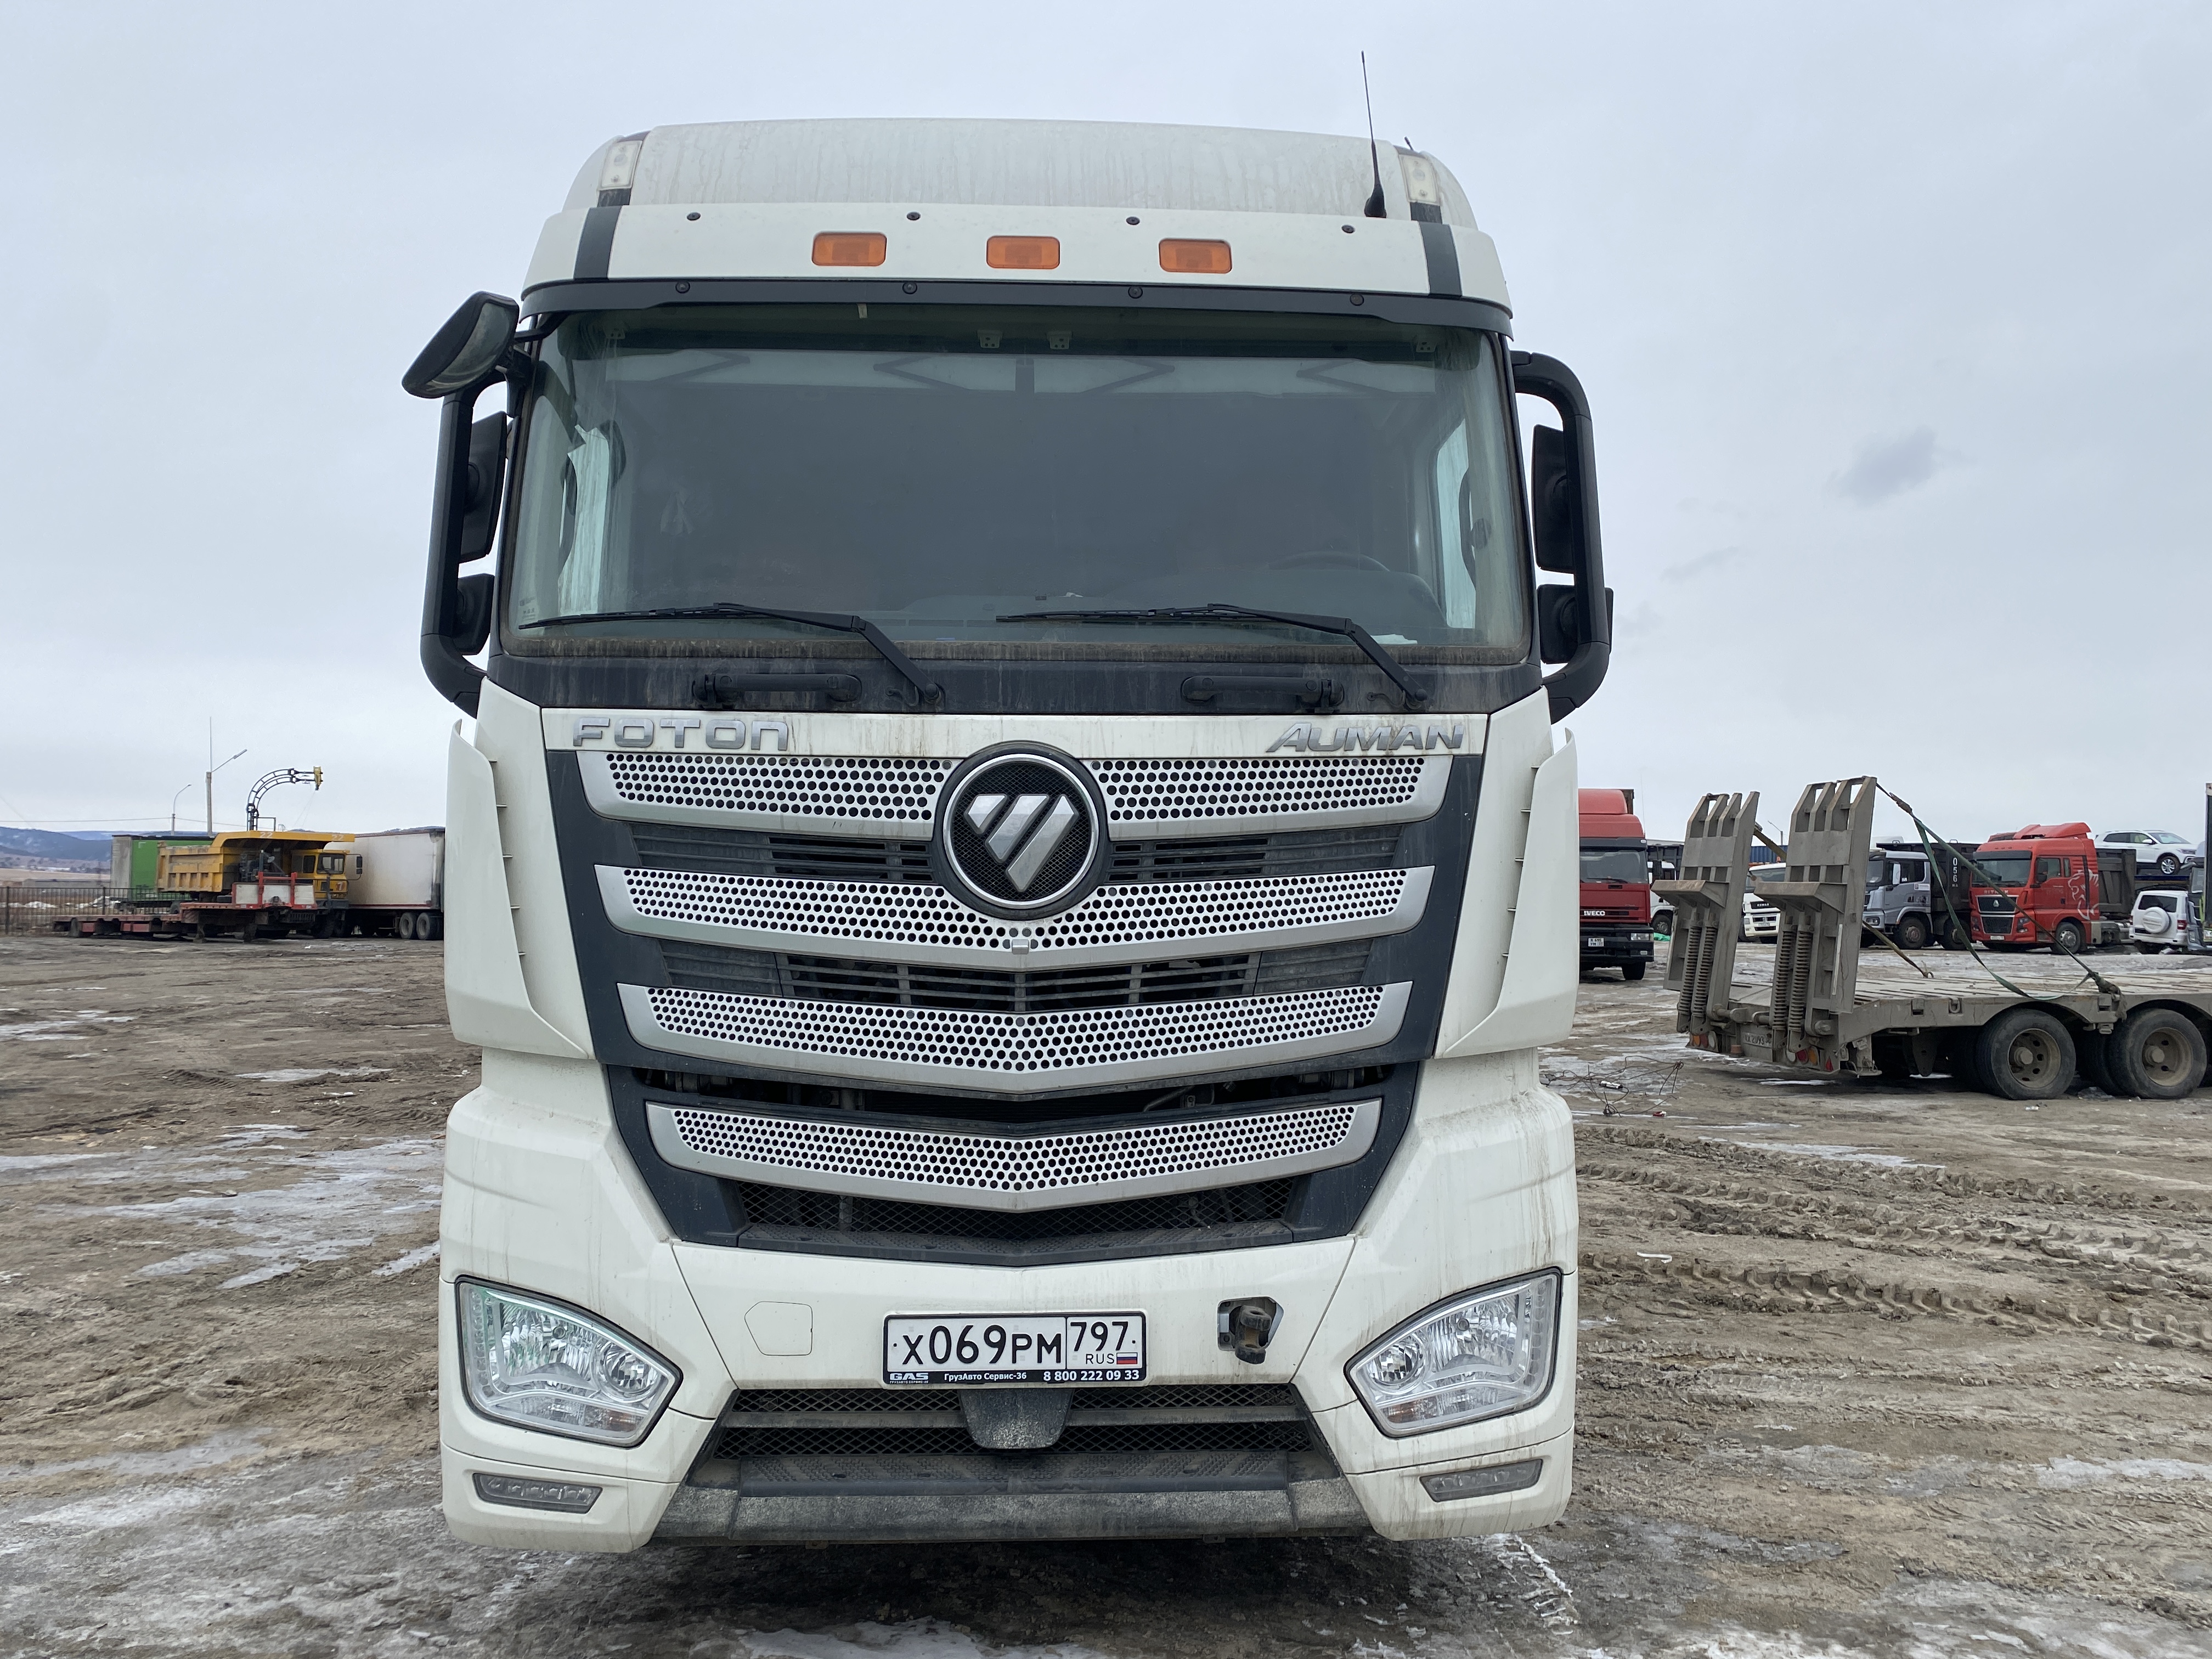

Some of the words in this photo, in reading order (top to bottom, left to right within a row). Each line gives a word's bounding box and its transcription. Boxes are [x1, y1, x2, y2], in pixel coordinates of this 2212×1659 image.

[573, 717, 788, 751] FOTON
[1266, 723, 1465, 752] AUMAN
[902, 1325, 1062, 1365] Х069РМ
[1070, 1321, 1128, 1351] 797
[1086, 1353, 1115, 1364] RUS
[944, 1373, 982, 1382] ГрузАвто
[984, 1372, 1027, 1381] Сервис-36
[1043, 1371, 1051, 1381] 8
[1054, 1371, 1077, 1381] 800
[1081, 1370, 1103, 1380] 222
[1106, 1370, 1121, 1380] 09
[1125, 1370, 1139, 1380] 33
